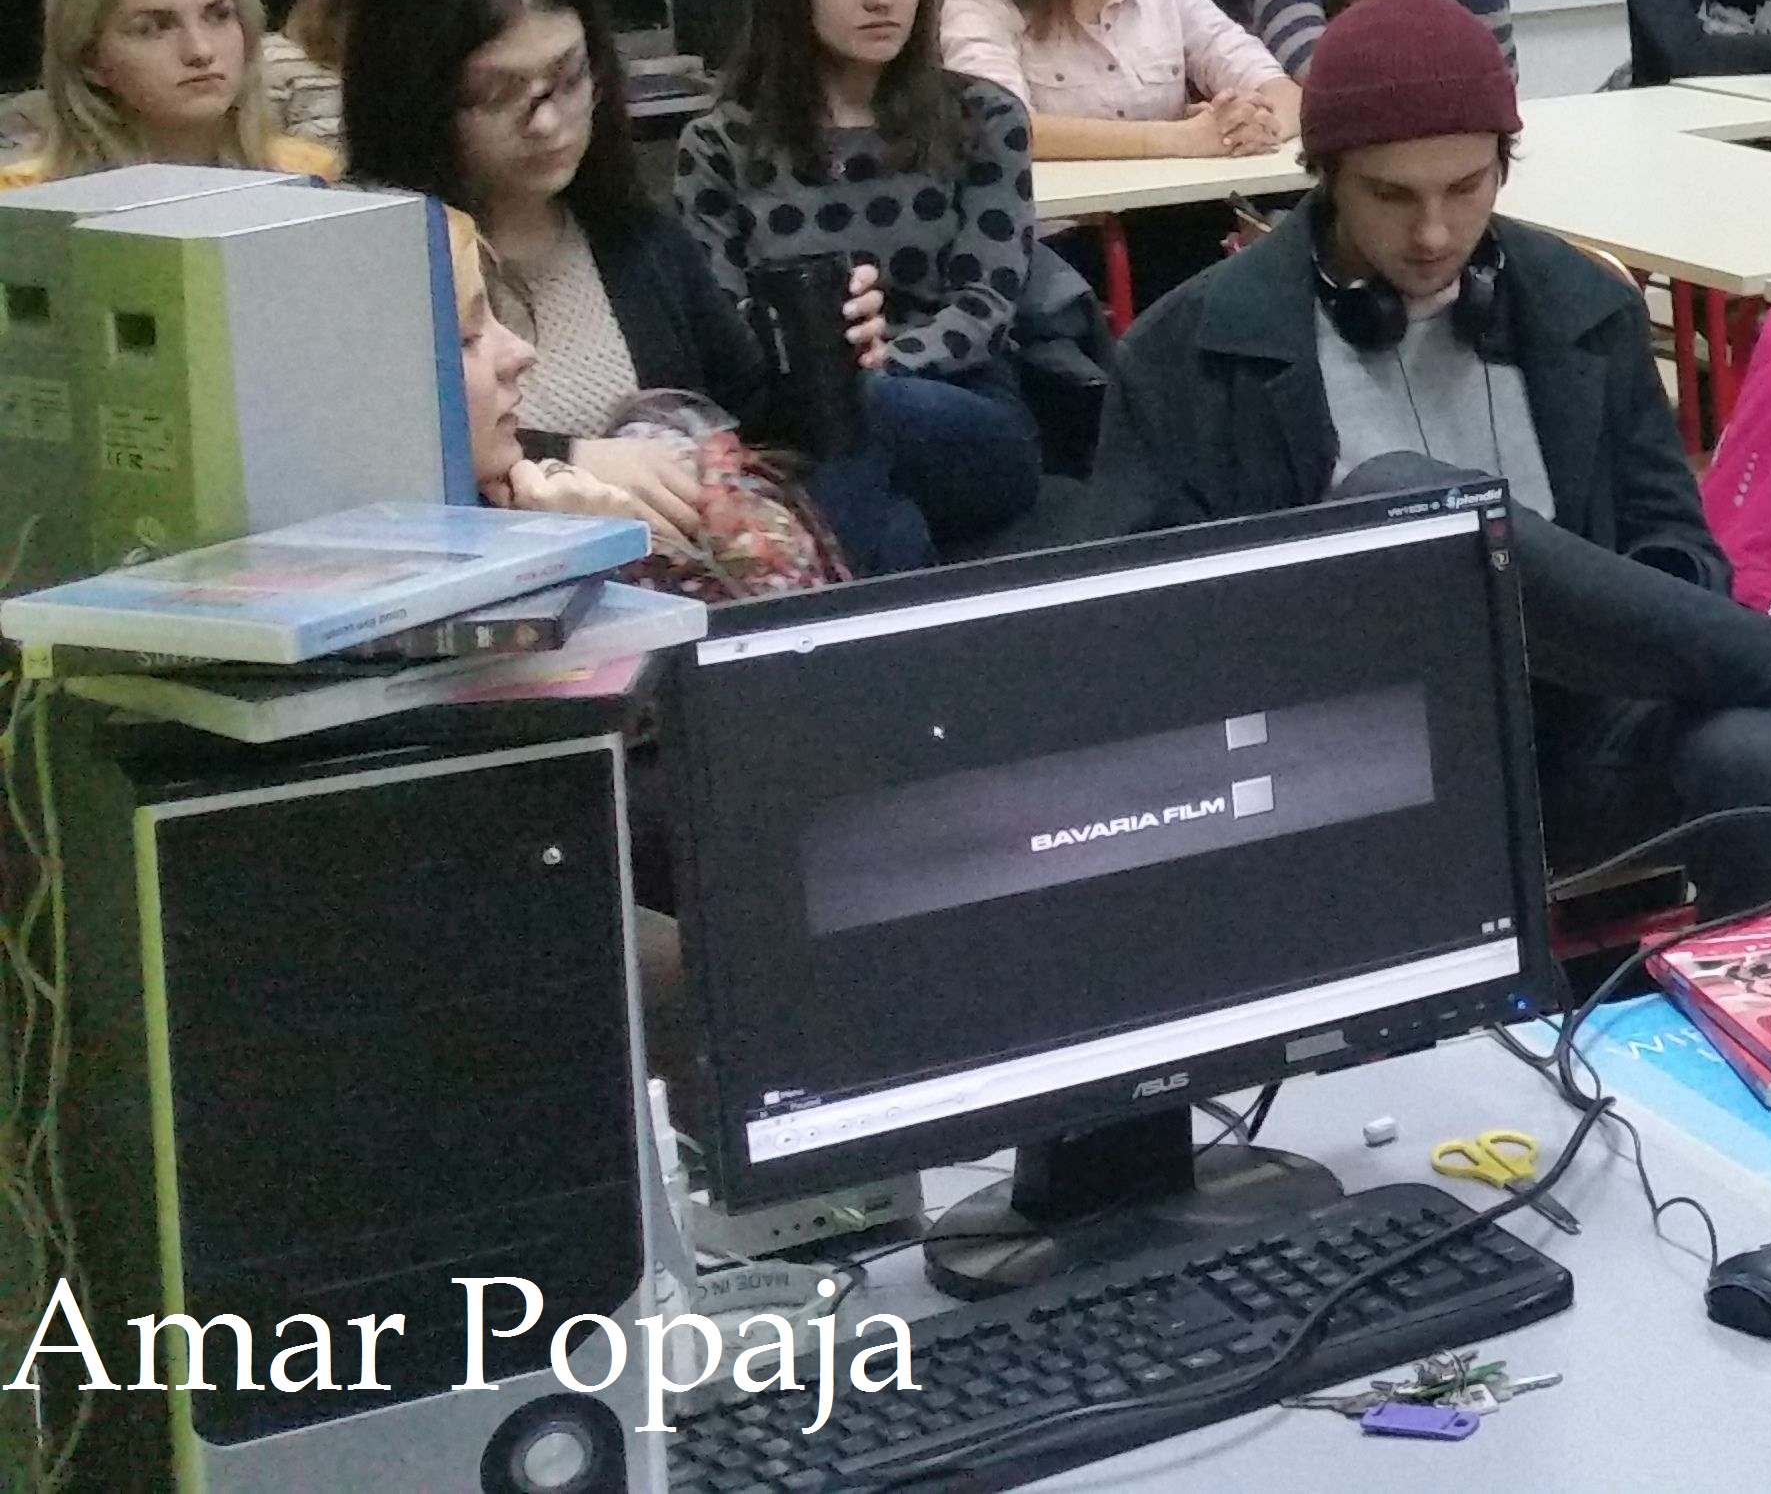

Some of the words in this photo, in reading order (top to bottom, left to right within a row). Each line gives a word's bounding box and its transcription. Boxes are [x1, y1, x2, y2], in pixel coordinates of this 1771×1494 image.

[1031, 812, 1159, 852] BAVARIA
[1162, 796, 1225, 824] FILM
[1132, 1072, 1190, 1100] ASUS
[737, 1272, 789, 1291] MADE
